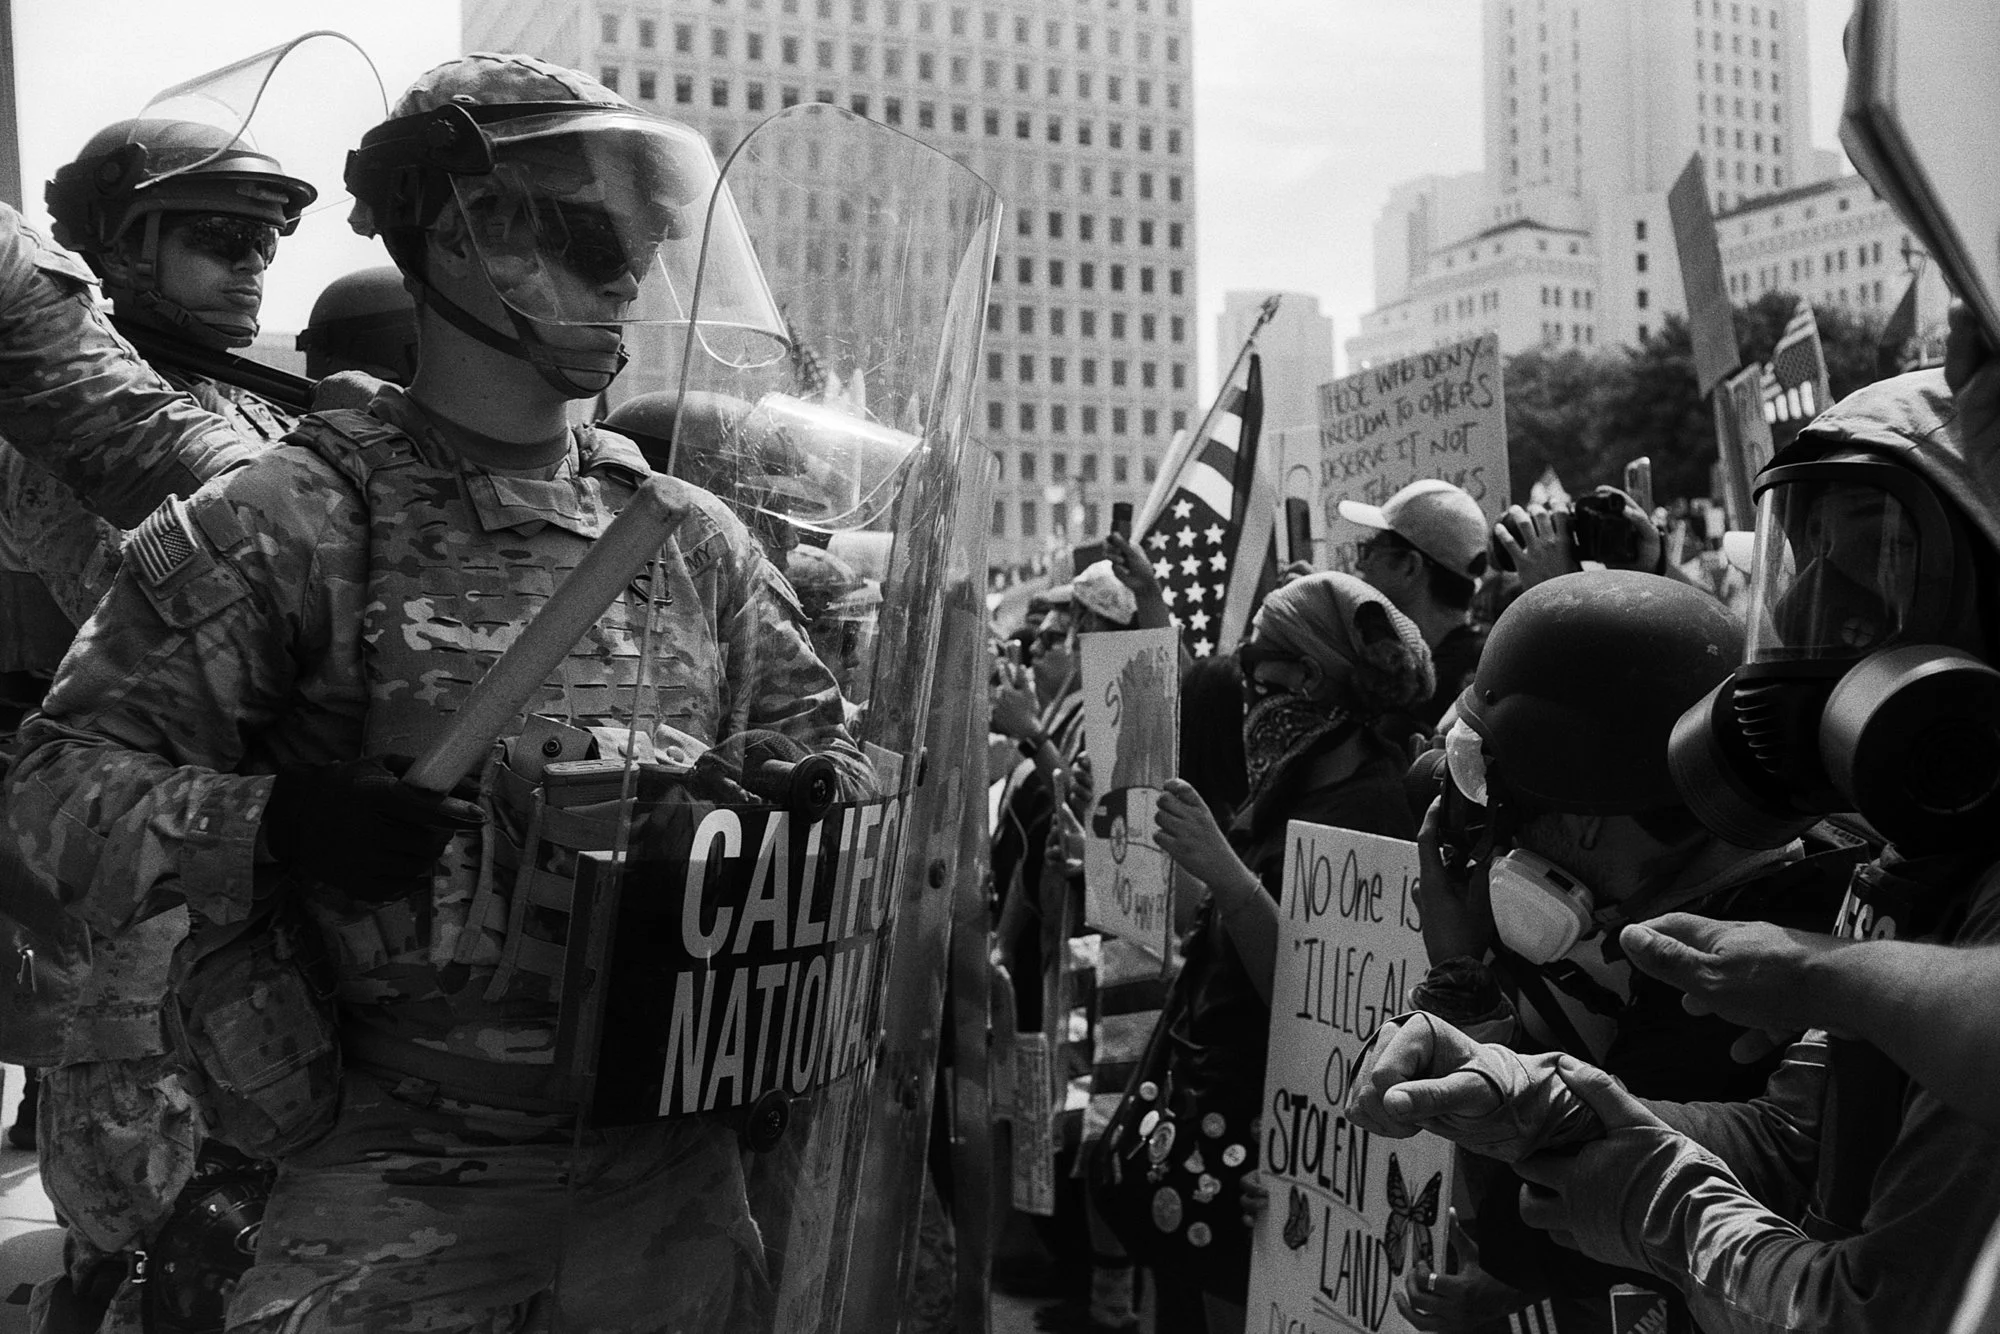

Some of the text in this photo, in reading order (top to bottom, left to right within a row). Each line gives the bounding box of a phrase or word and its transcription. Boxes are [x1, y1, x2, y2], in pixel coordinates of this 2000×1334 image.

[1422, 338, 1483, 382] DENY
[1395, 430, 1421, 467] IT
[1429, 421, 1479, 456] NOT
[1340, 848, 1383, 924] One
[1400, 865, 1423, 933] is
[1267, 1087, 1370, 1213] STOLEN
[1320, 1206, 1393, 1333] LAND
